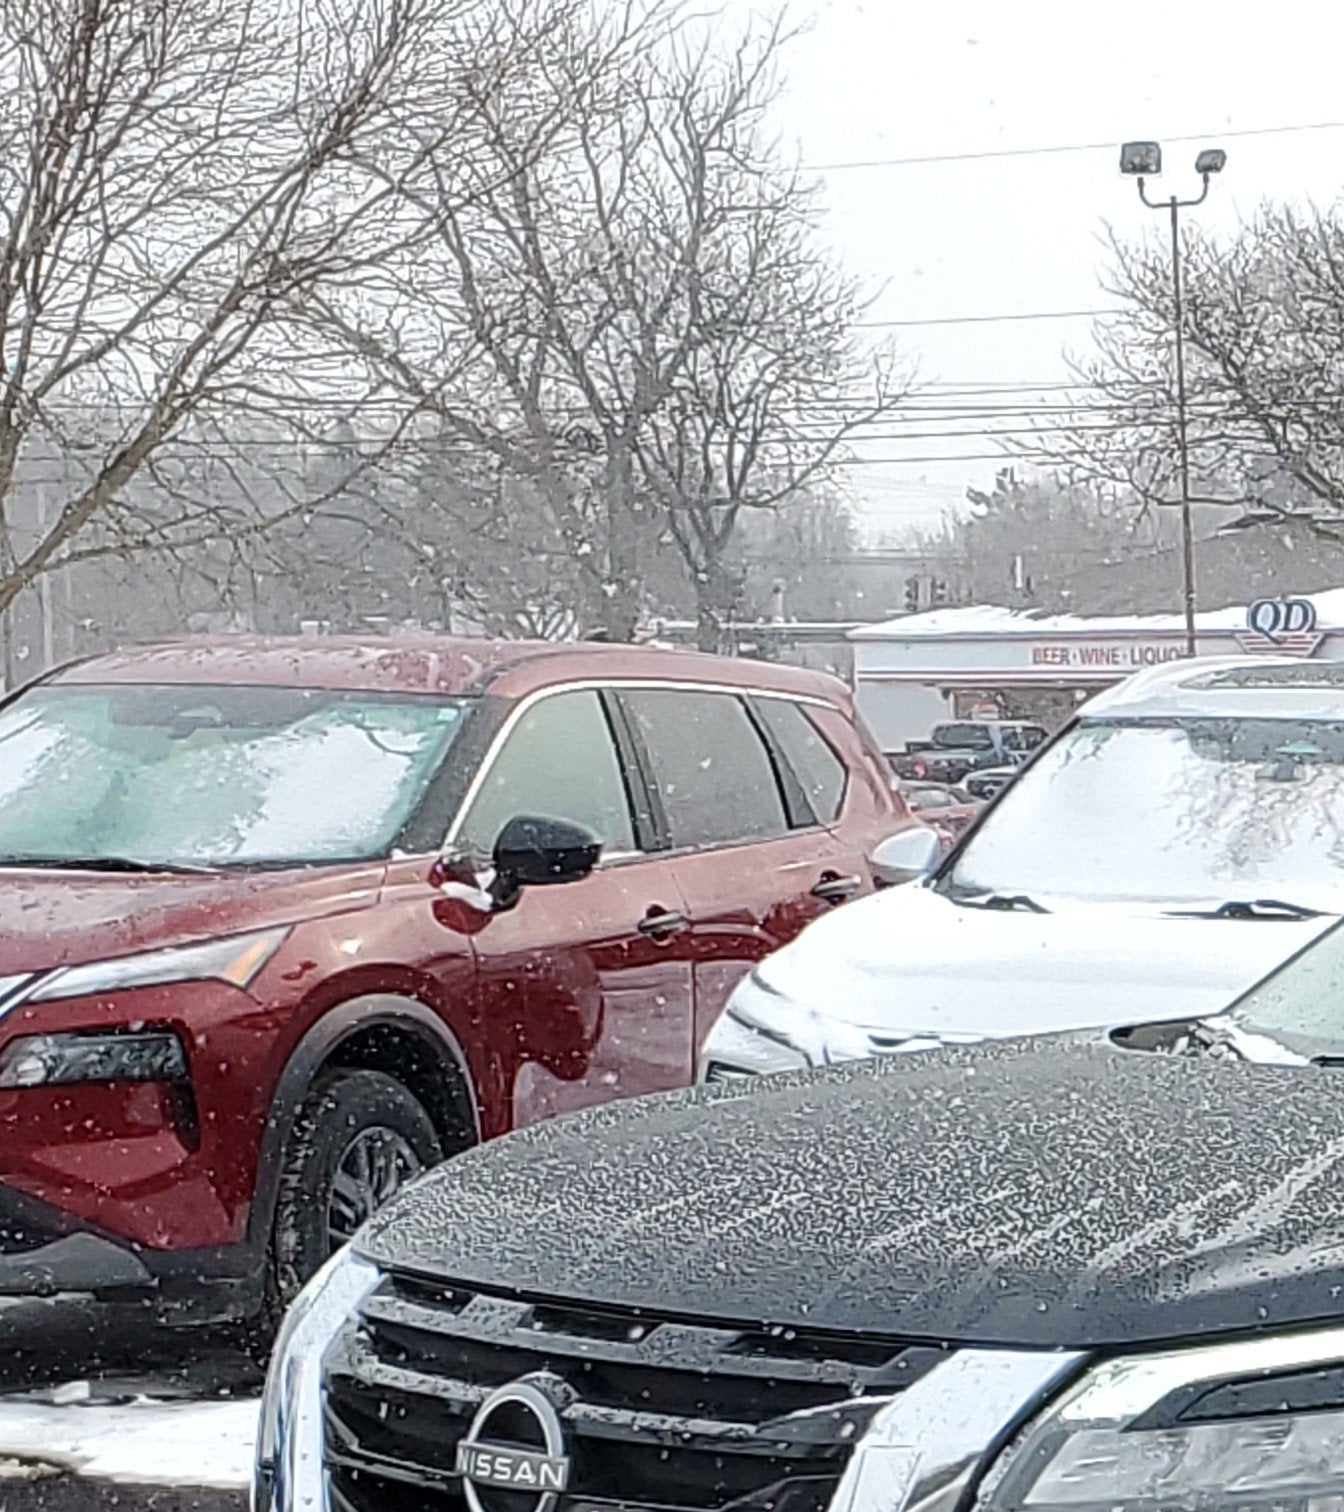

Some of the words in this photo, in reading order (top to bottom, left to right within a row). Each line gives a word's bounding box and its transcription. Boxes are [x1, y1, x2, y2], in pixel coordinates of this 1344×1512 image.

[1247, 599, 1317, 646] QD
[1032, 646, 1071, 665] BEER
[1080, 646, 1121, 665] WINE
[458, 1447, 564, 1487] NISSAN
